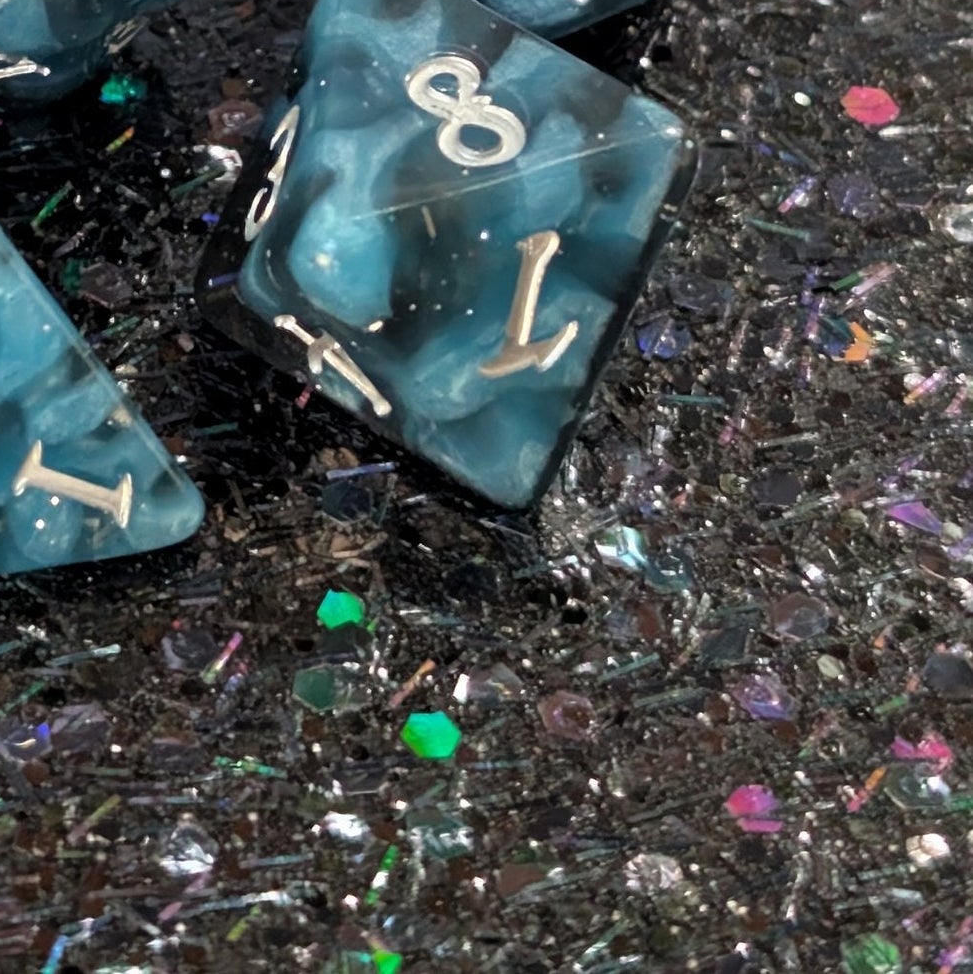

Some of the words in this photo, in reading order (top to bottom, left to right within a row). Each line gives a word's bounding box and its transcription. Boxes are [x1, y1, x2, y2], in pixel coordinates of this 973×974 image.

[405, 54, 527, 166] 8
[244, 104, 301, 242] 3
[13, 439, 133, 529] 1
